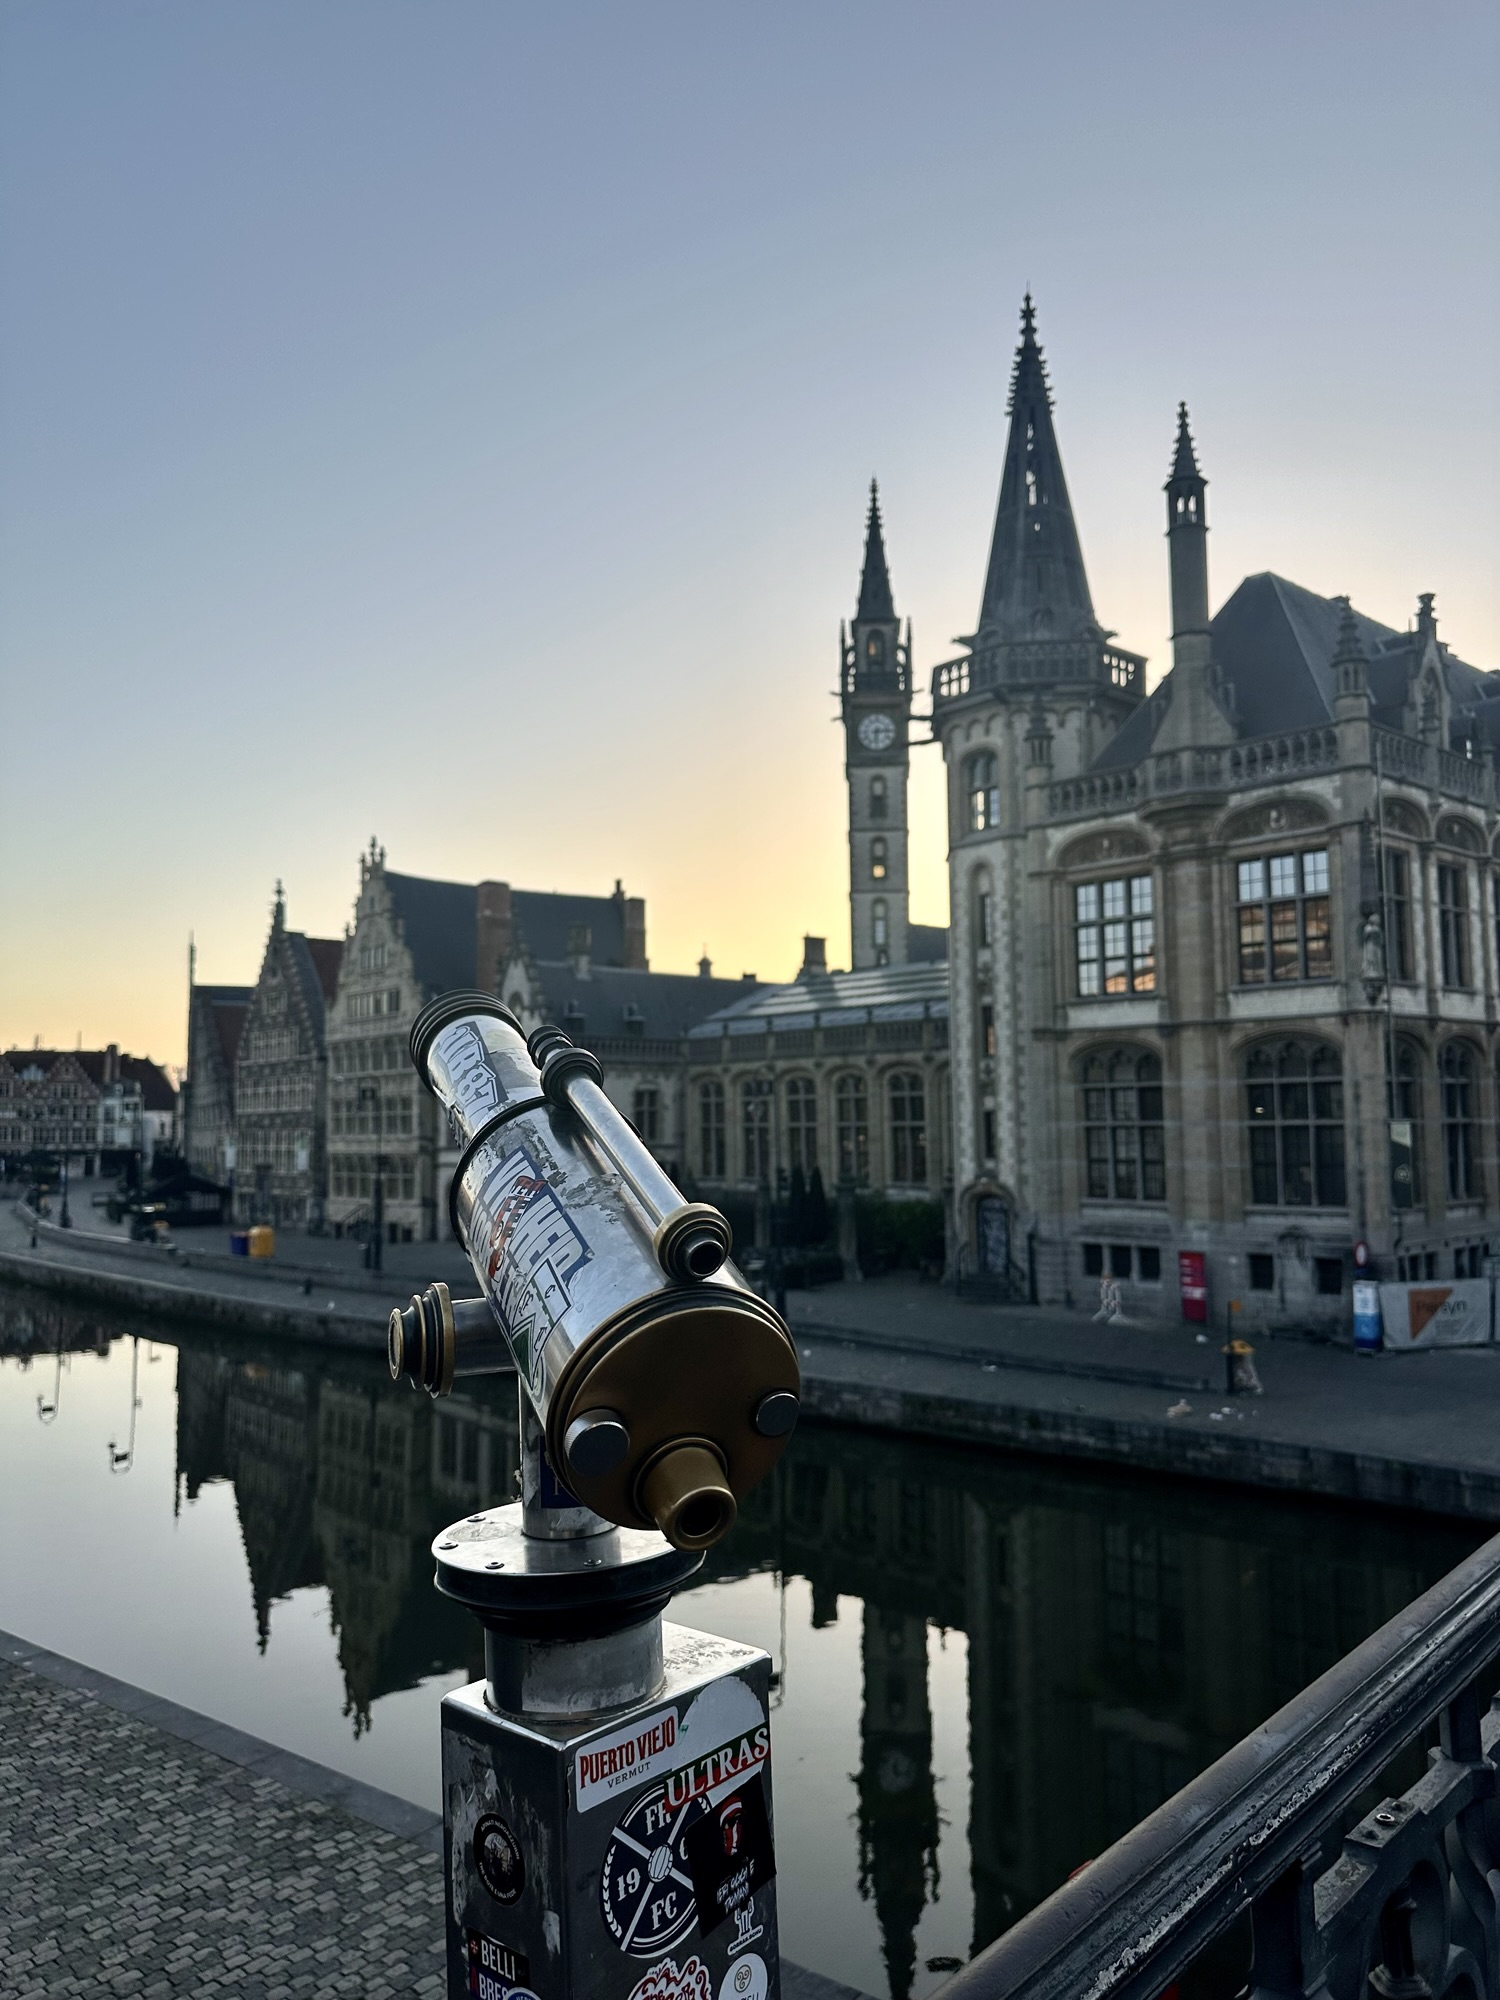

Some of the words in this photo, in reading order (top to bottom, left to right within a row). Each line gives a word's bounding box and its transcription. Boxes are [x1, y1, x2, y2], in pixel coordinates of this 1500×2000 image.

[579, 1740, 635, 1790] PUERTO
[636, 1715, 676, 1760] VIEJO
[666, 1727, 770, 1807] ULTRAS
[607, 1761, 651, 1789] VERMUT
[616, 1867, 641, 1902] 19
[650, 1890, 678, 1931] FC
[481, 1939, 516, 1982] BELLI
